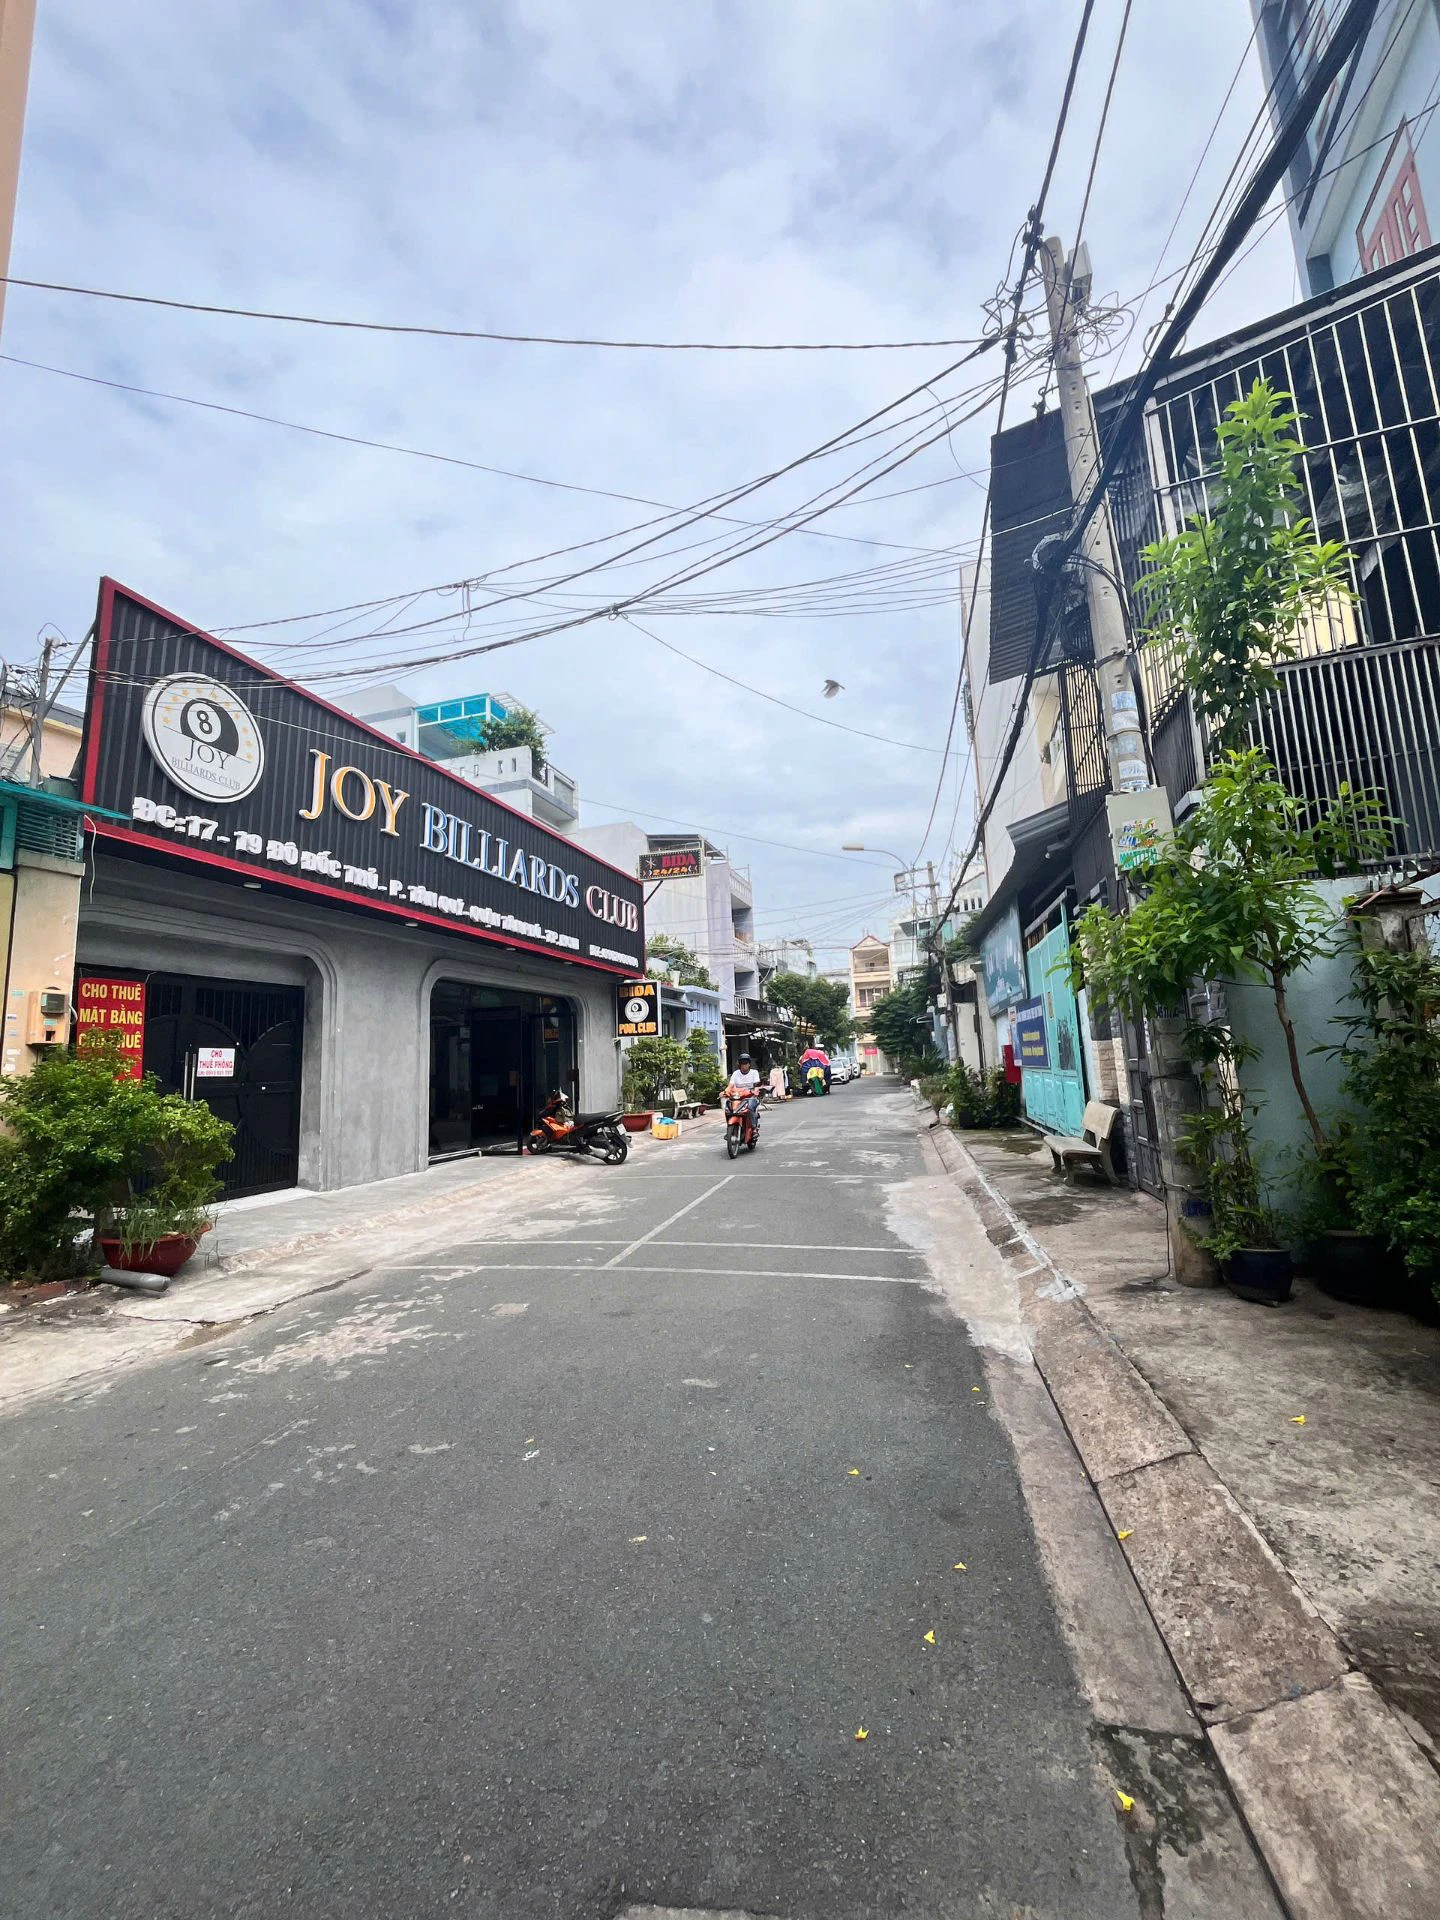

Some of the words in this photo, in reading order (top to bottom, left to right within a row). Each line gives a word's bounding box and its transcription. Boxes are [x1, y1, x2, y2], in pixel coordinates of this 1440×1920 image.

[196, 710, 213, 735] 8
[185, 740, 230, 770] JOY
[171, 757, 217, 781] BILLIARDS
[218, 775, 241, 791] CLUB
[233, 830, 263, 855] 19
[299, 748, 410, 837] JOY
[420, 803, 580, 908] BILLIARDS
[586, 885, 639, 932] CLUB
[653, 866, 688, 876] 24/24
[662, 852, 697, 867] BIDA
[81, 982, 108, 999] CHO
[111, 983, 142, 1000] THUÊ
[619, 984, 655, 997] BIDA
[79, 1005, 107, 1027] MẶT
[110, 1004, 142, 1025] BẰNG
[210, 1049, 222, 1058] CHO
